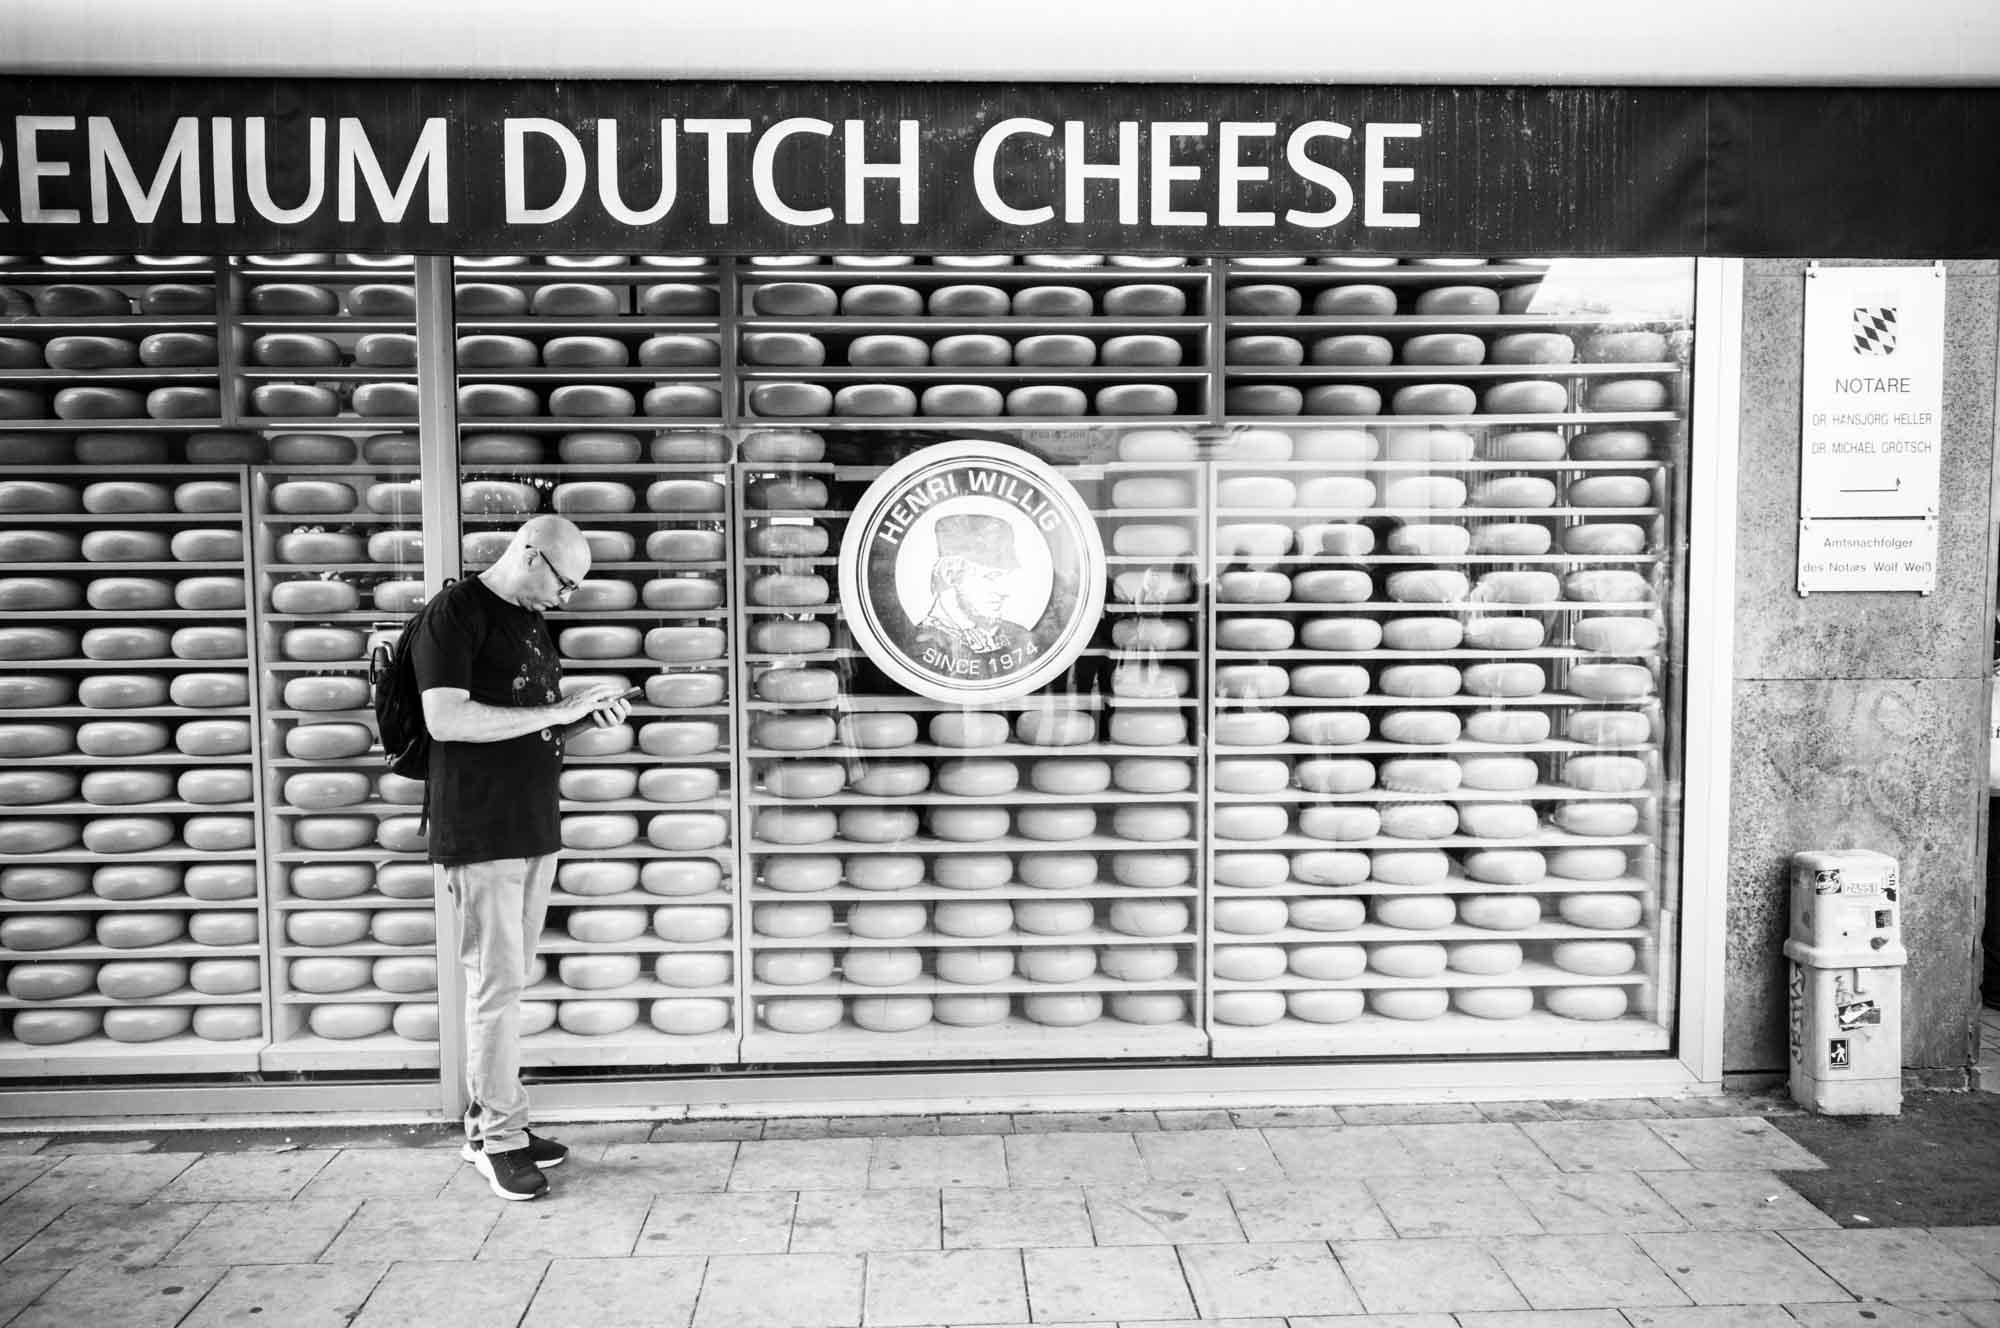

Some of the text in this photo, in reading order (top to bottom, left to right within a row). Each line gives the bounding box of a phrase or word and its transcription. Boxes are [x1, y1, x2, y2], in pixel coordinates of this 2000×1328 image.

[0, 115, 1423, 228] EMIUM DUTCH CHEESE
[1835, 377, 1912, 394] NOTARE
[1812, 413, 1827, 426] DR
[1894, 412, 1933, 425] HELLER
[1811, 442, 1827, 455] DR
[1832, 441, 1877, 455] MICHAEL
[879, 470, 1063, 545] HENRI WILLIG
[922, 640, 1039, 676] SINCE 1974
